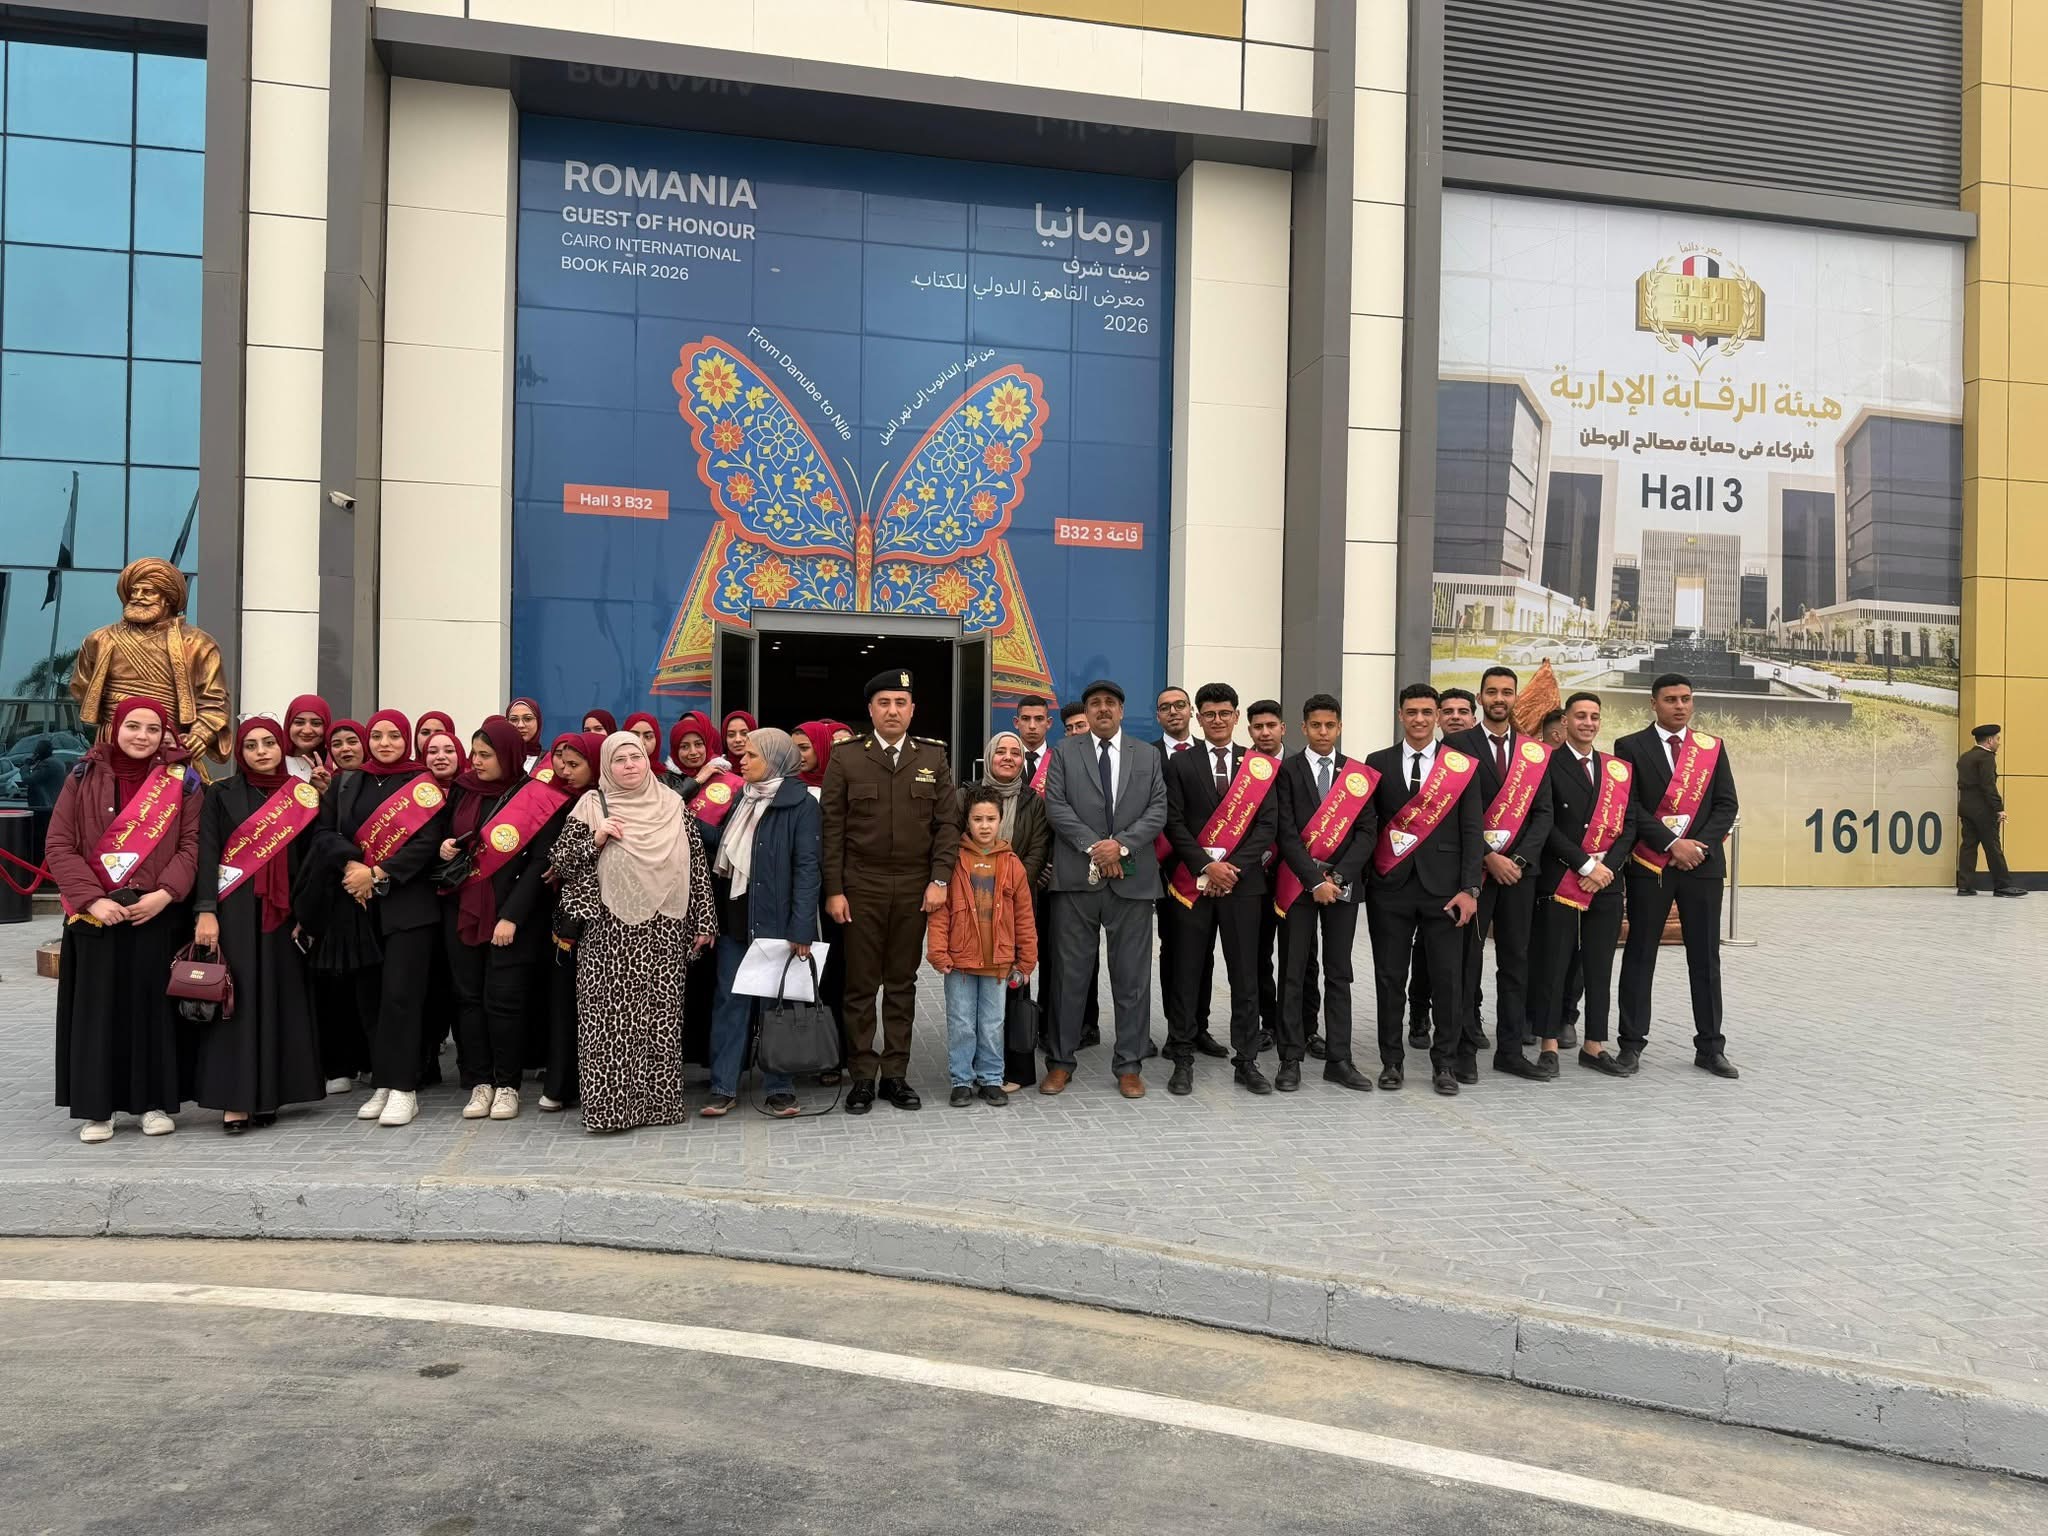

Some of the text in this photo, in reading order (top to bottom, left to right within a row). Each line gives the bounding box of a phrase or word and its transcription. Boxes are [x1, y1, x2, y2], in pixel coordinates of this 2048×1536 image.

[564, 160, 758, 210] ROMANIA
[562, 205, 756, 240] GUEST OF HONOUR
[1035, 203, 1150, 257] رومانيا
[561, 232, 742, 262] CAIRO INTERNATIONAL
[561, 256, 689, 281] BOOK FAIR 2026
[1063, 255, 1150, 284] ضيف شرف
[913, 271, 1145, 309] معرض القاهرة الدولي للكتاب
[1103, 314, 1149, 335] 2026
[747, 327, 852, 442] From Danube to Nile
[879, 348, 996, 446] من نهر الدانوب إلى نهر النيل
[1550, 364, 1842, 427] هيئة الرقابة الإدارية
[1579, 427, 1630, 451] الوطن
[1632, 432, 1687, 455] مصالح
[1690, 435, 1735, 456] حماية
[1766, 441, 1815, 463] شركاء
[580, 493, 653, 510] Hall 3 B32
[1641, 473, 1743, 513] Hall 3
[1060, 524, 1138, 543] قاعة 3 B32
[1805, 808, 1943, 856] 16100
